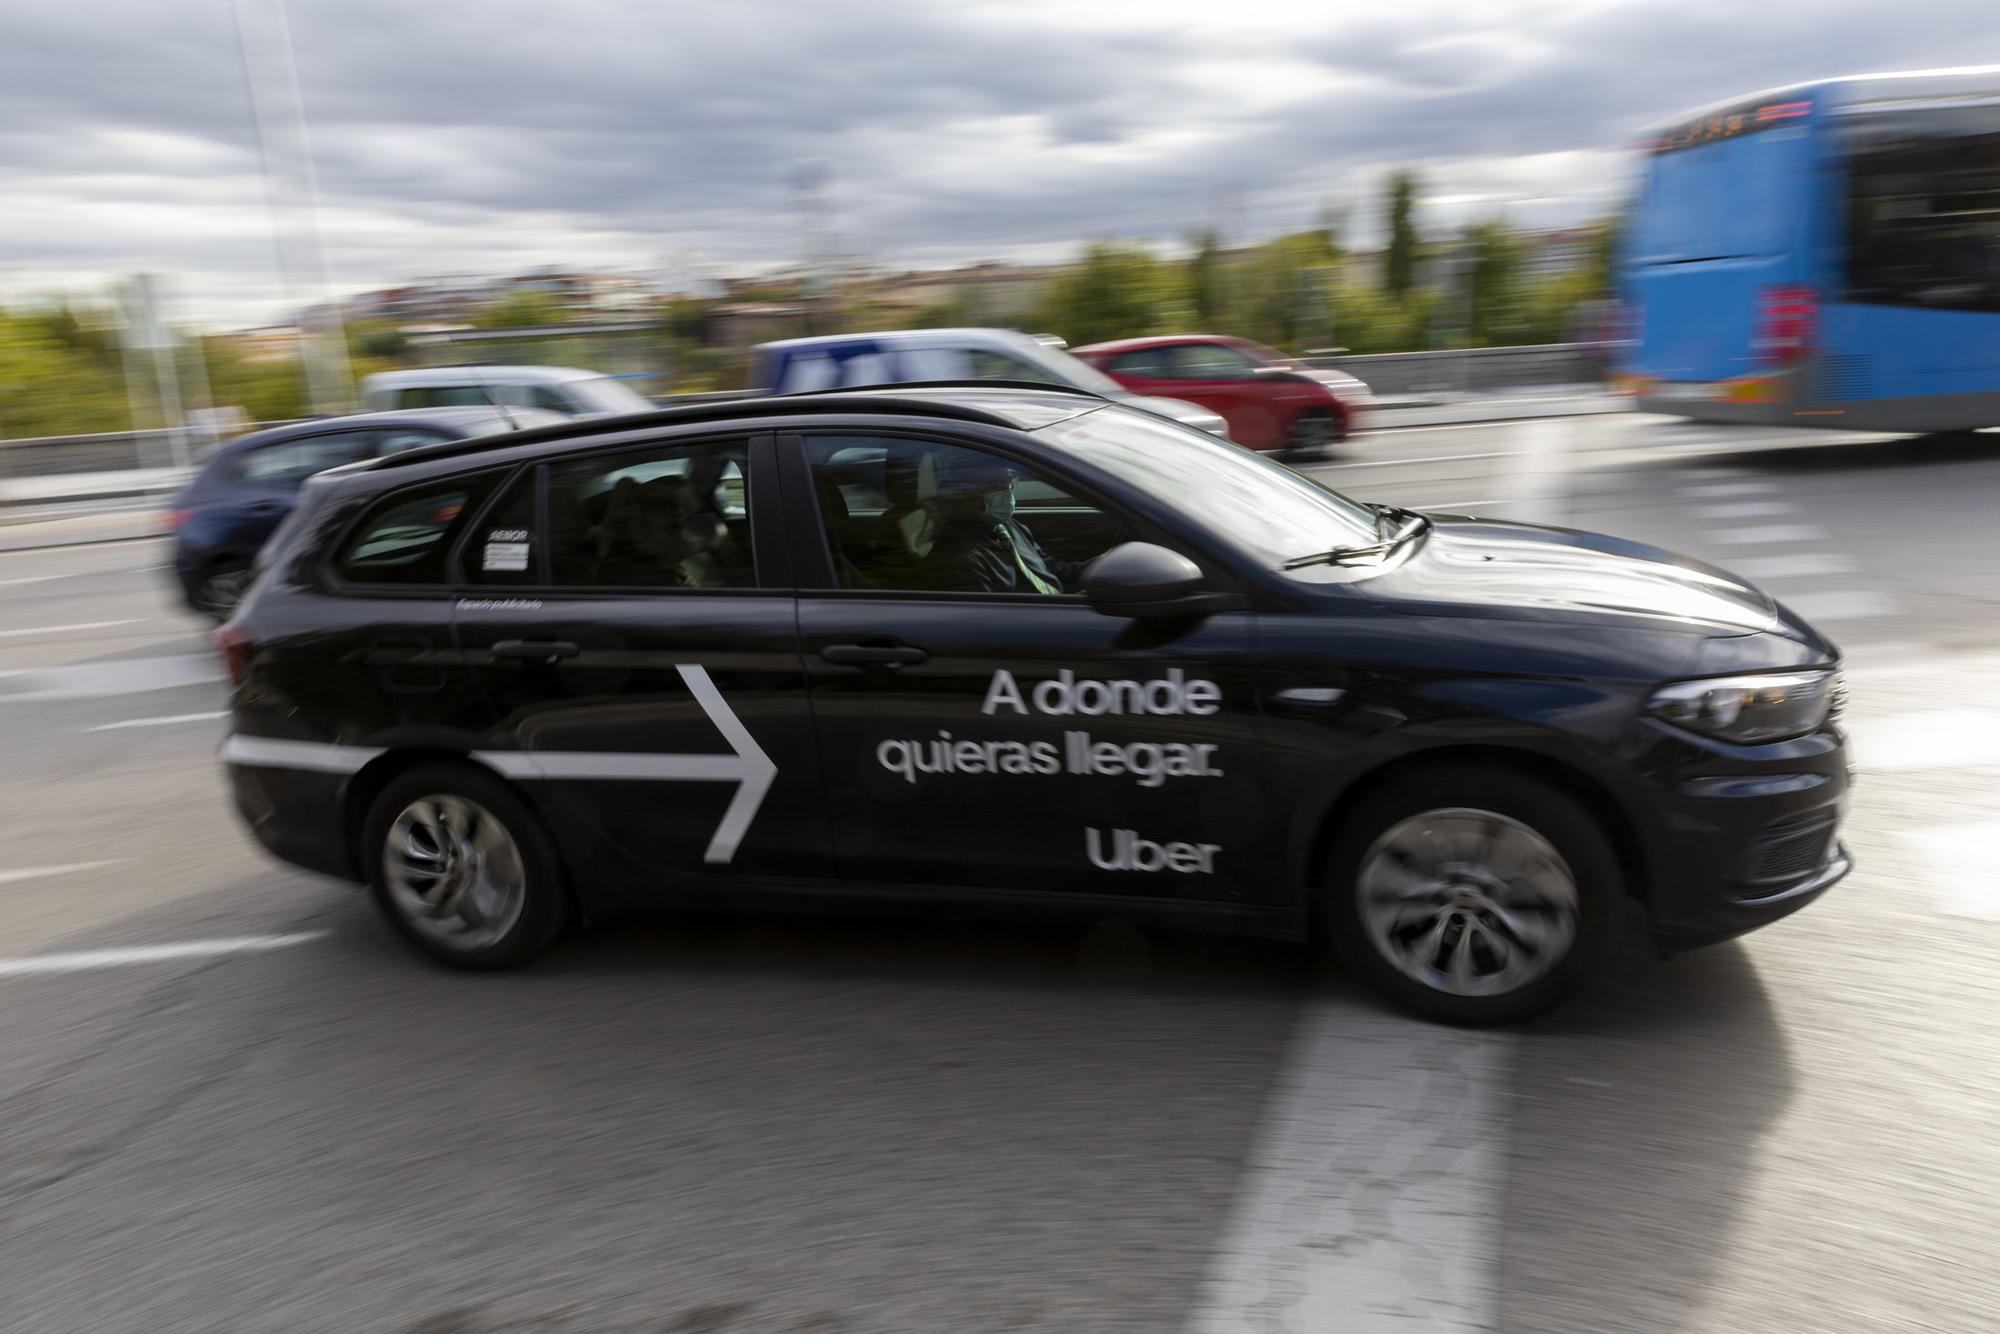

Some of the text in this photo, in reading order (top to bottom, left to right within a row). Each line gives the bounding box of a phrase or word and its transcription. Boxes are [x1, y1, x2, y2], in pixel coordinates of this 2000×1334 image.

[981, 668, 1222, 715] A donde
[876, 730, 1224, 787] quieras llegar.
[1085, 827, 1222, 873] Uber
